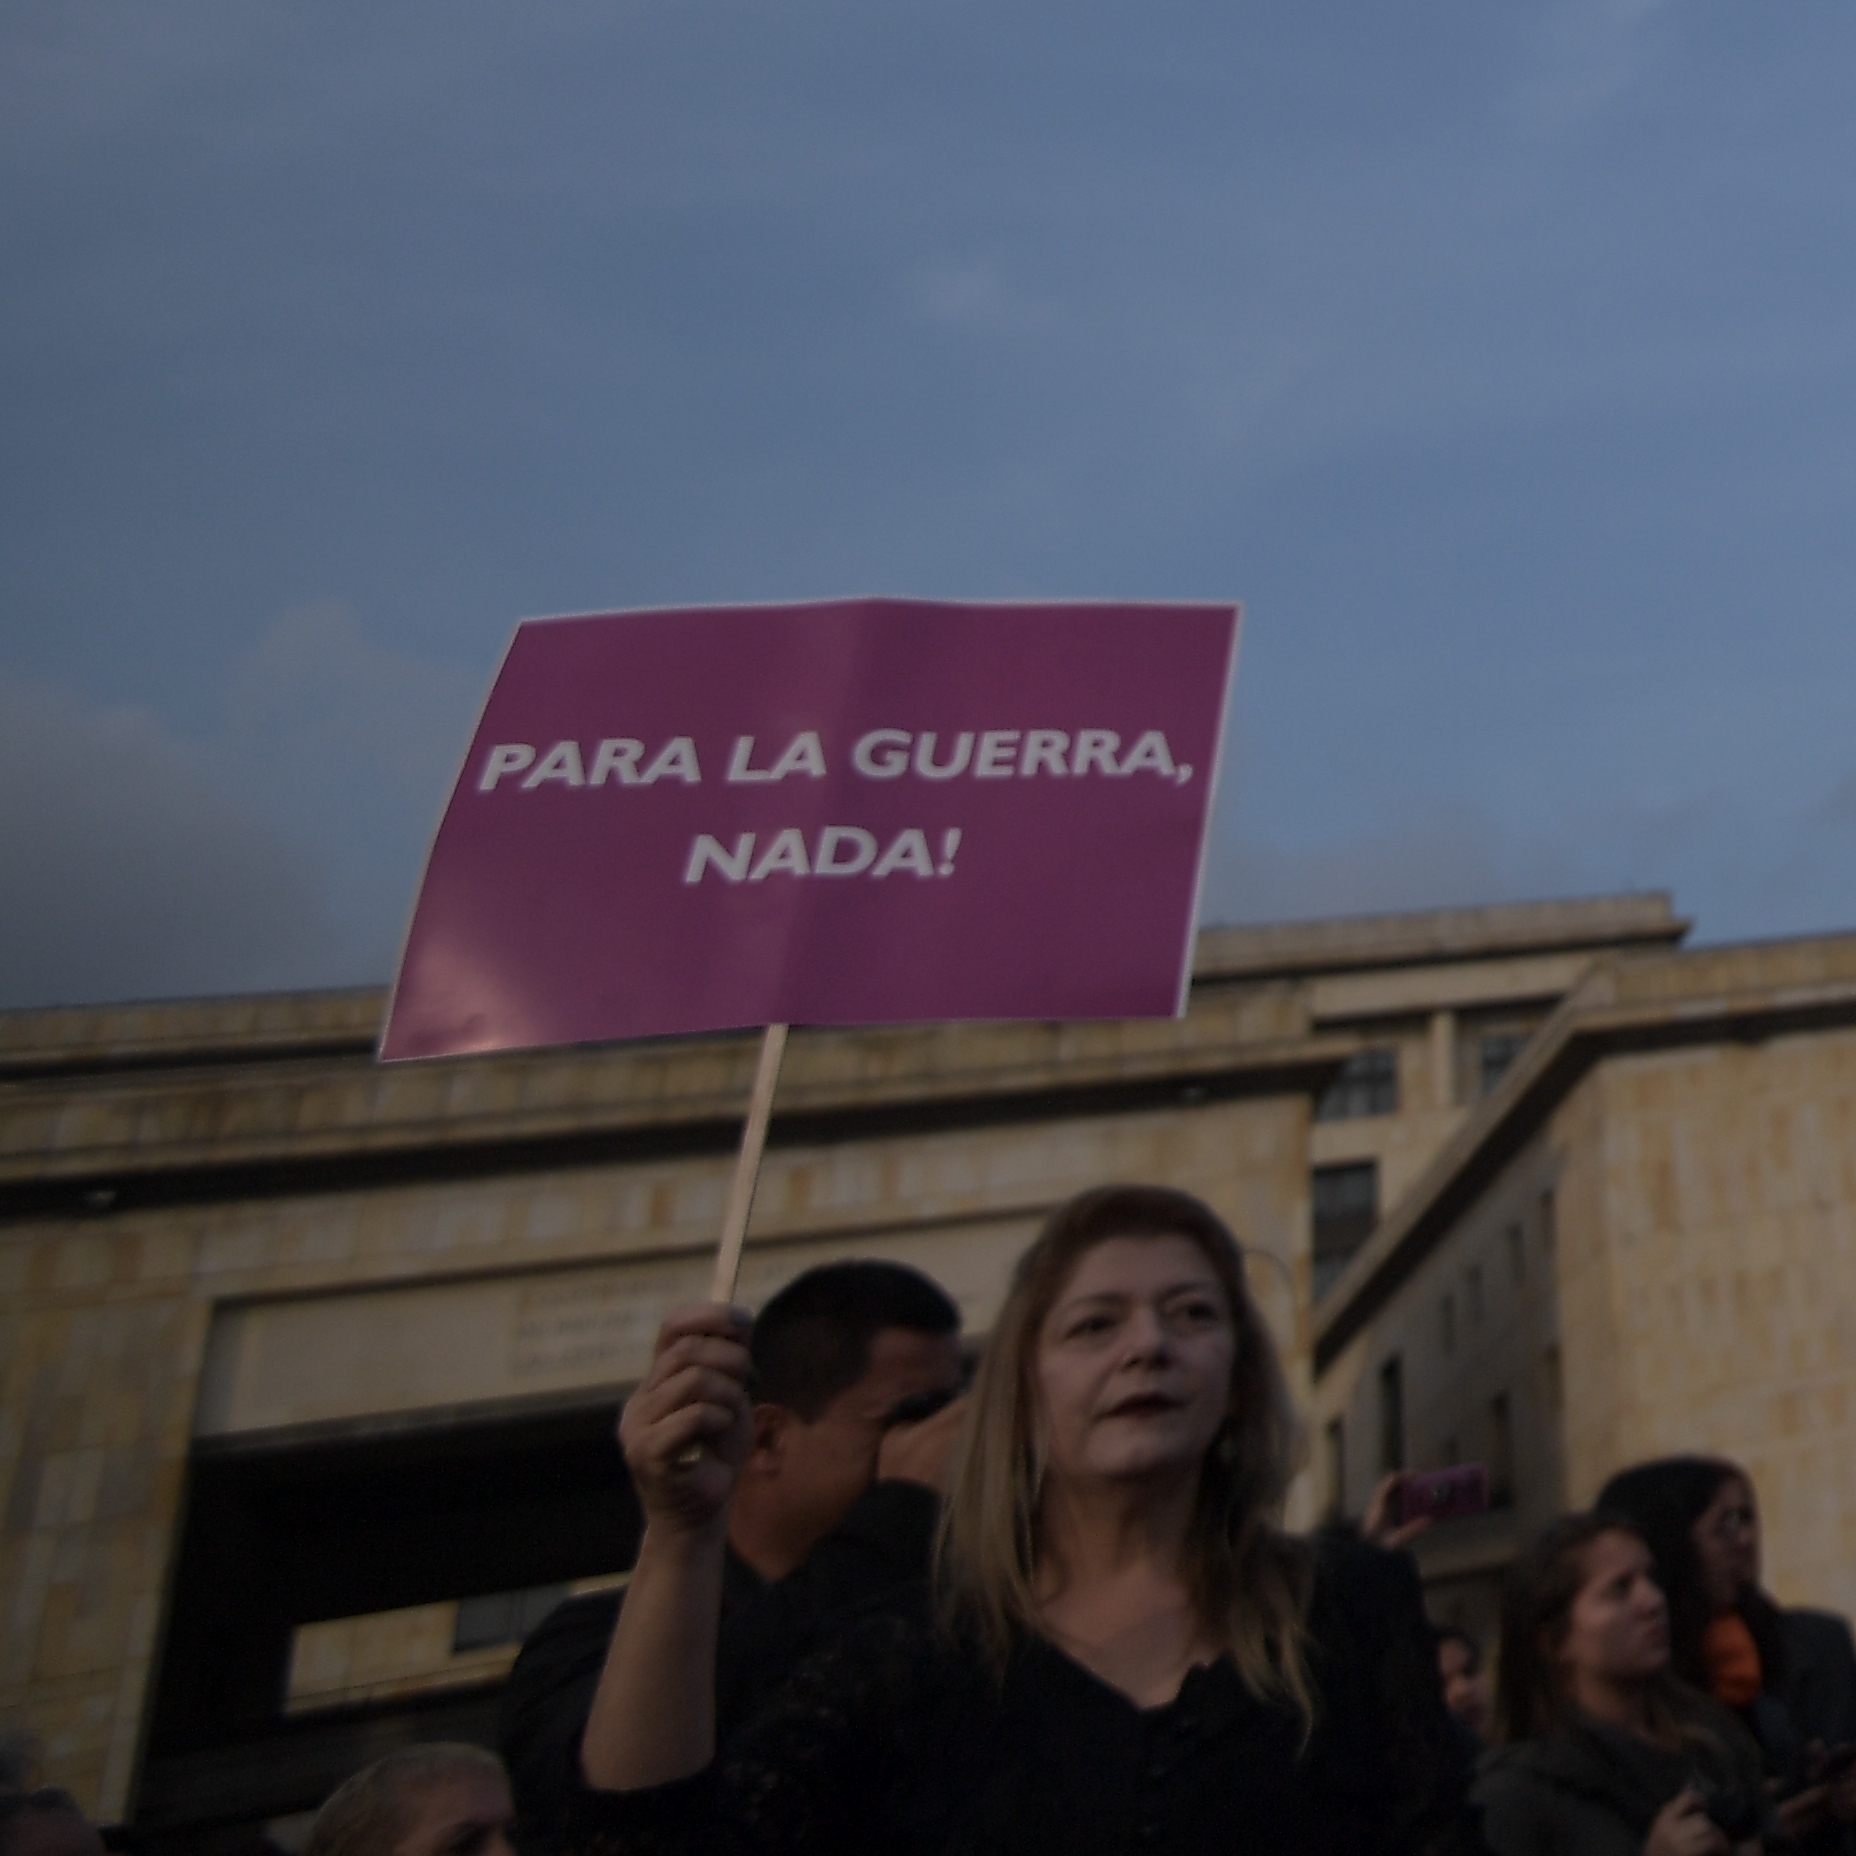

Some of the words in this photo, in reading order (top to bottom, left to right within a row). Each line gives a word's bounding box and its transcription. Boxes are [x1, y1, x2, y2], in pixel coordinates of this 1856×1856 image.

[478, 737, 701, 792] PARA
[726, 730, 826, 784] LA
[852, 728, 1194, 785] GUERRA,
[684, 825, 962, 884] NADA!
